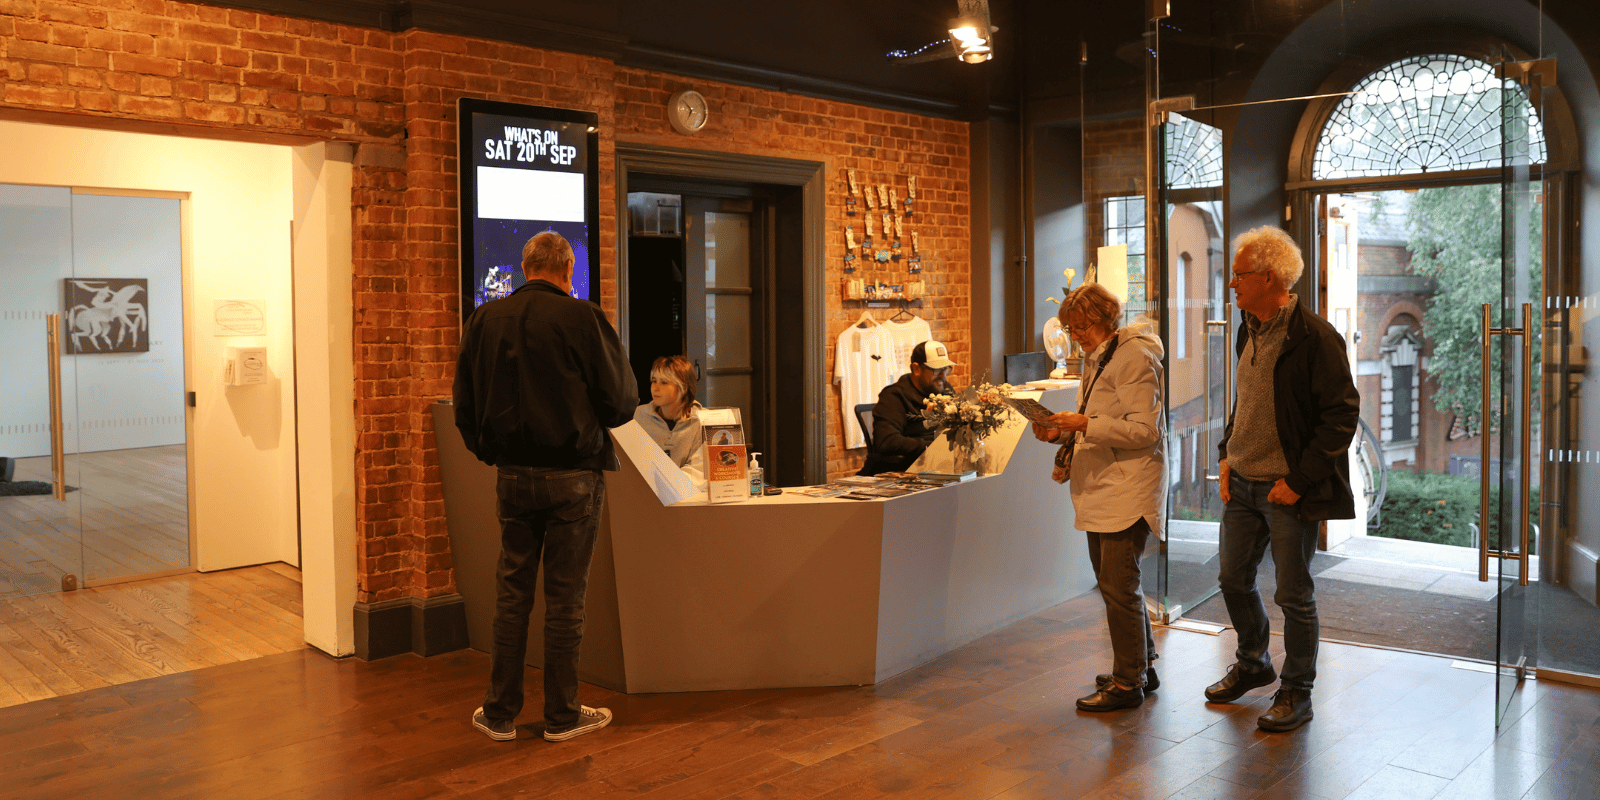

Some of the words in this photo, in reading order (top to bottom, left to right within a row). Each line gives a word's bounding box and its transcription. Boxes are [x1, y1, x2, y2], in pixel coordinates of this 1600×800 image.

[504, 126, 541, 143] WHAT'S
[544, 130, 558, 145] ON
[485, 139, 513, 160] SAT
[517, 141, 547, 163] 20TH
[550, 145, 576, 165] SEP
